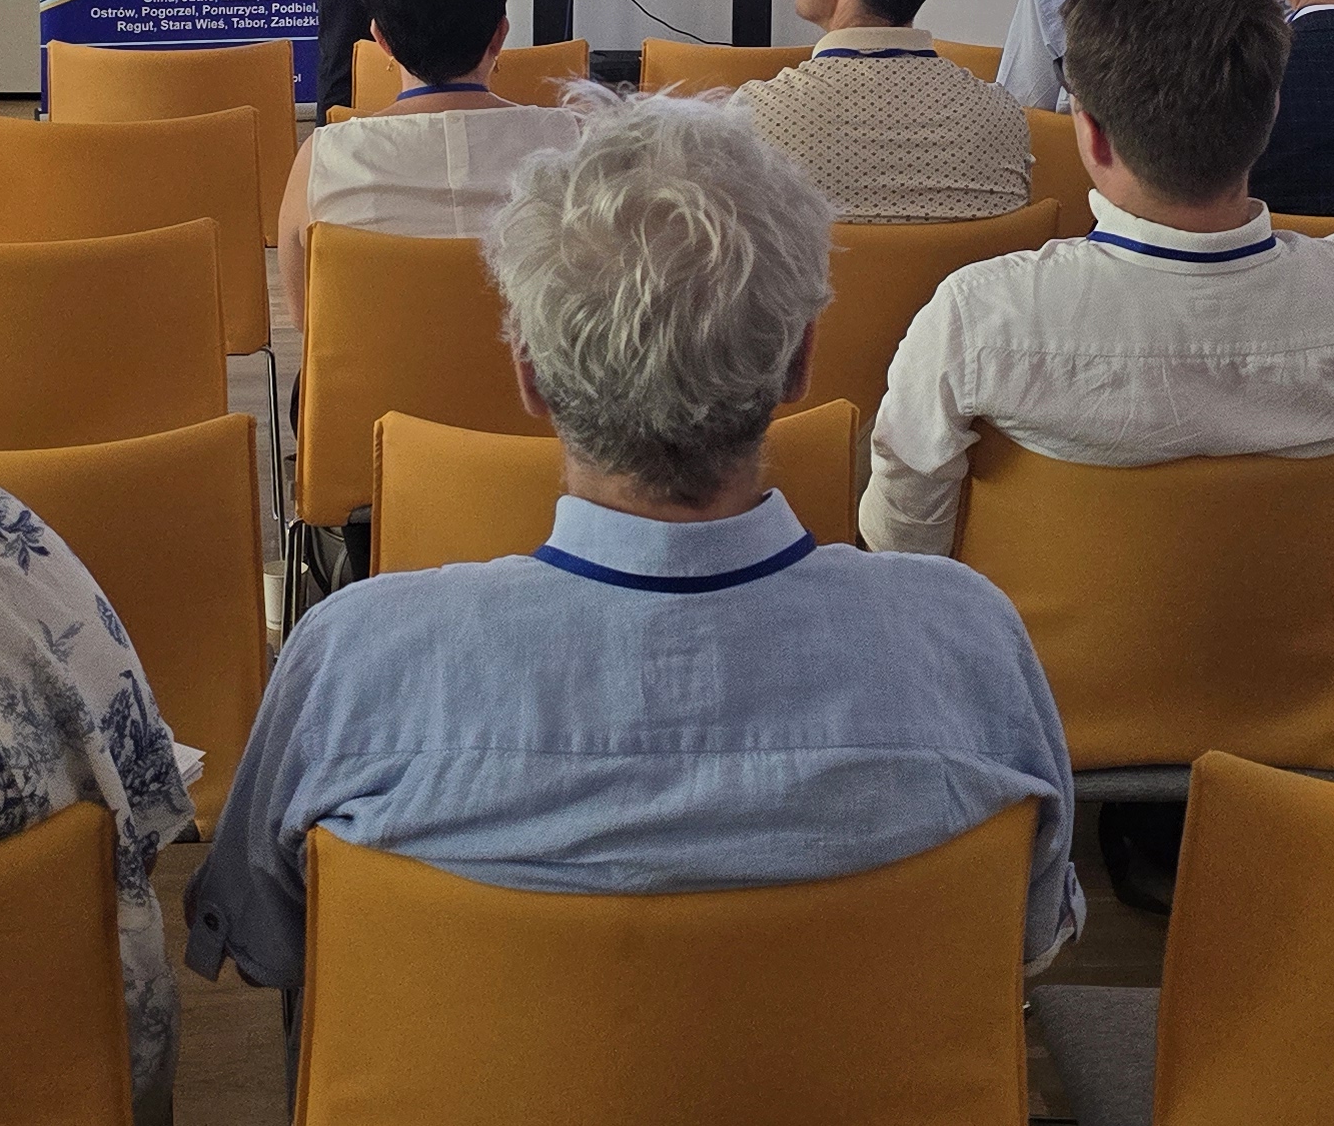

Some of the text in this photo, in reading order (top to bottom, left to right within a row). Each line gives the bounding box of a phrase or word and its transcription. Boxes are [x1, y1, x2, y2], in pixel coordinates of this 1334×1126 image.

[90, 2, 319, 19] Ostrów, Pogorzel, Ponurzyca, Podbiel,
[117, 20, 157, 34] Regut,
[160, 19, 192, 31] Stara
[195, 18, 228, 30] Wieś,
[231, 17, 268, 29] Tabor,
